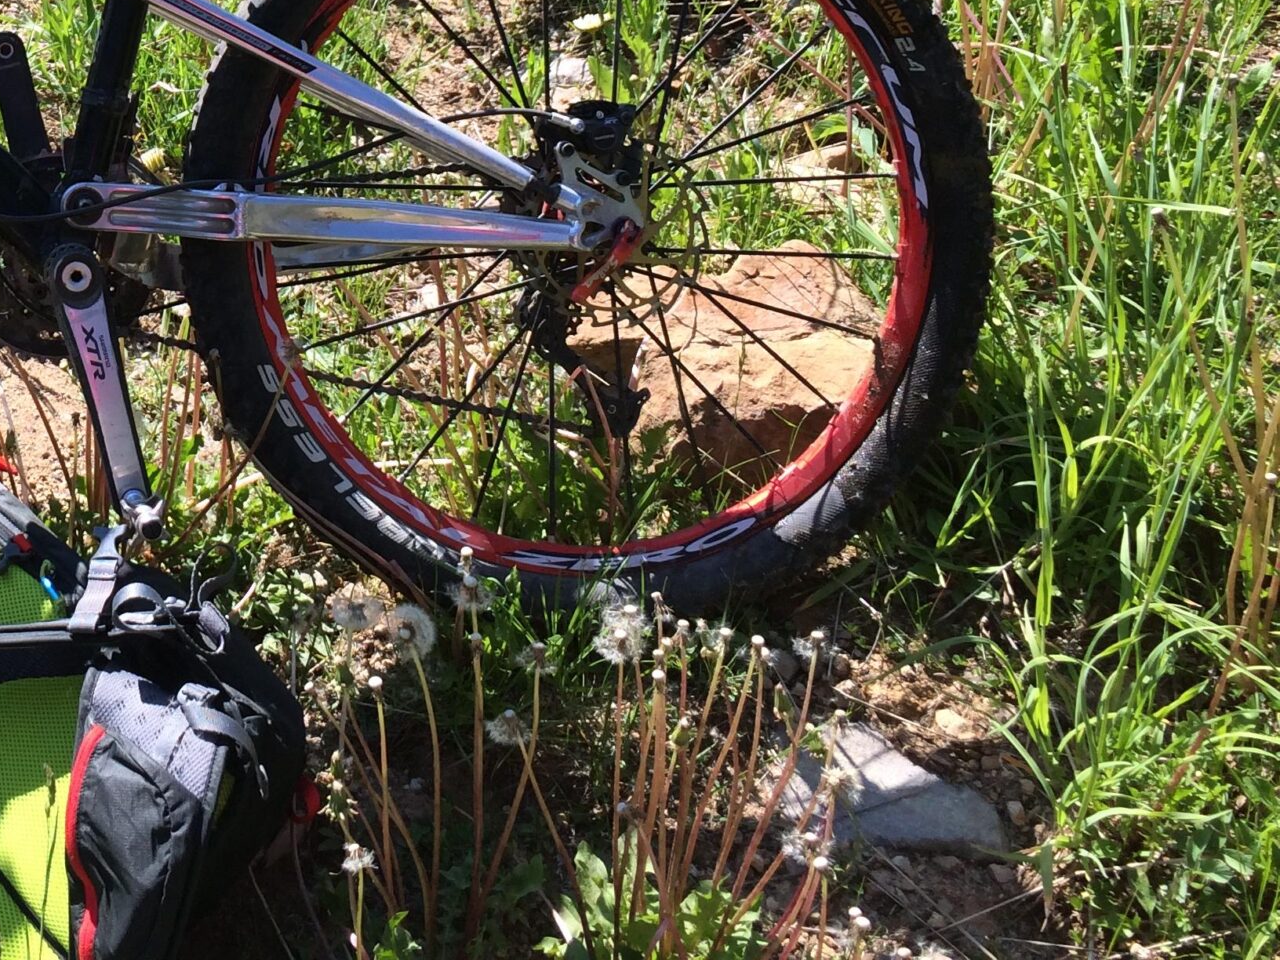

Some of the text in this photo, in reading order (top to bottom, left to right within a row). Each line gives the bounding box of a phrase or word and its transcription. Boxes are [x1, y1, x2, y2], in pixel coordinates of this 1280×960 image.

[894, 36, 926, 73] 2.4
[81, 324, 107, 383] XTR
[500, 516, 757, 572] ZERO
